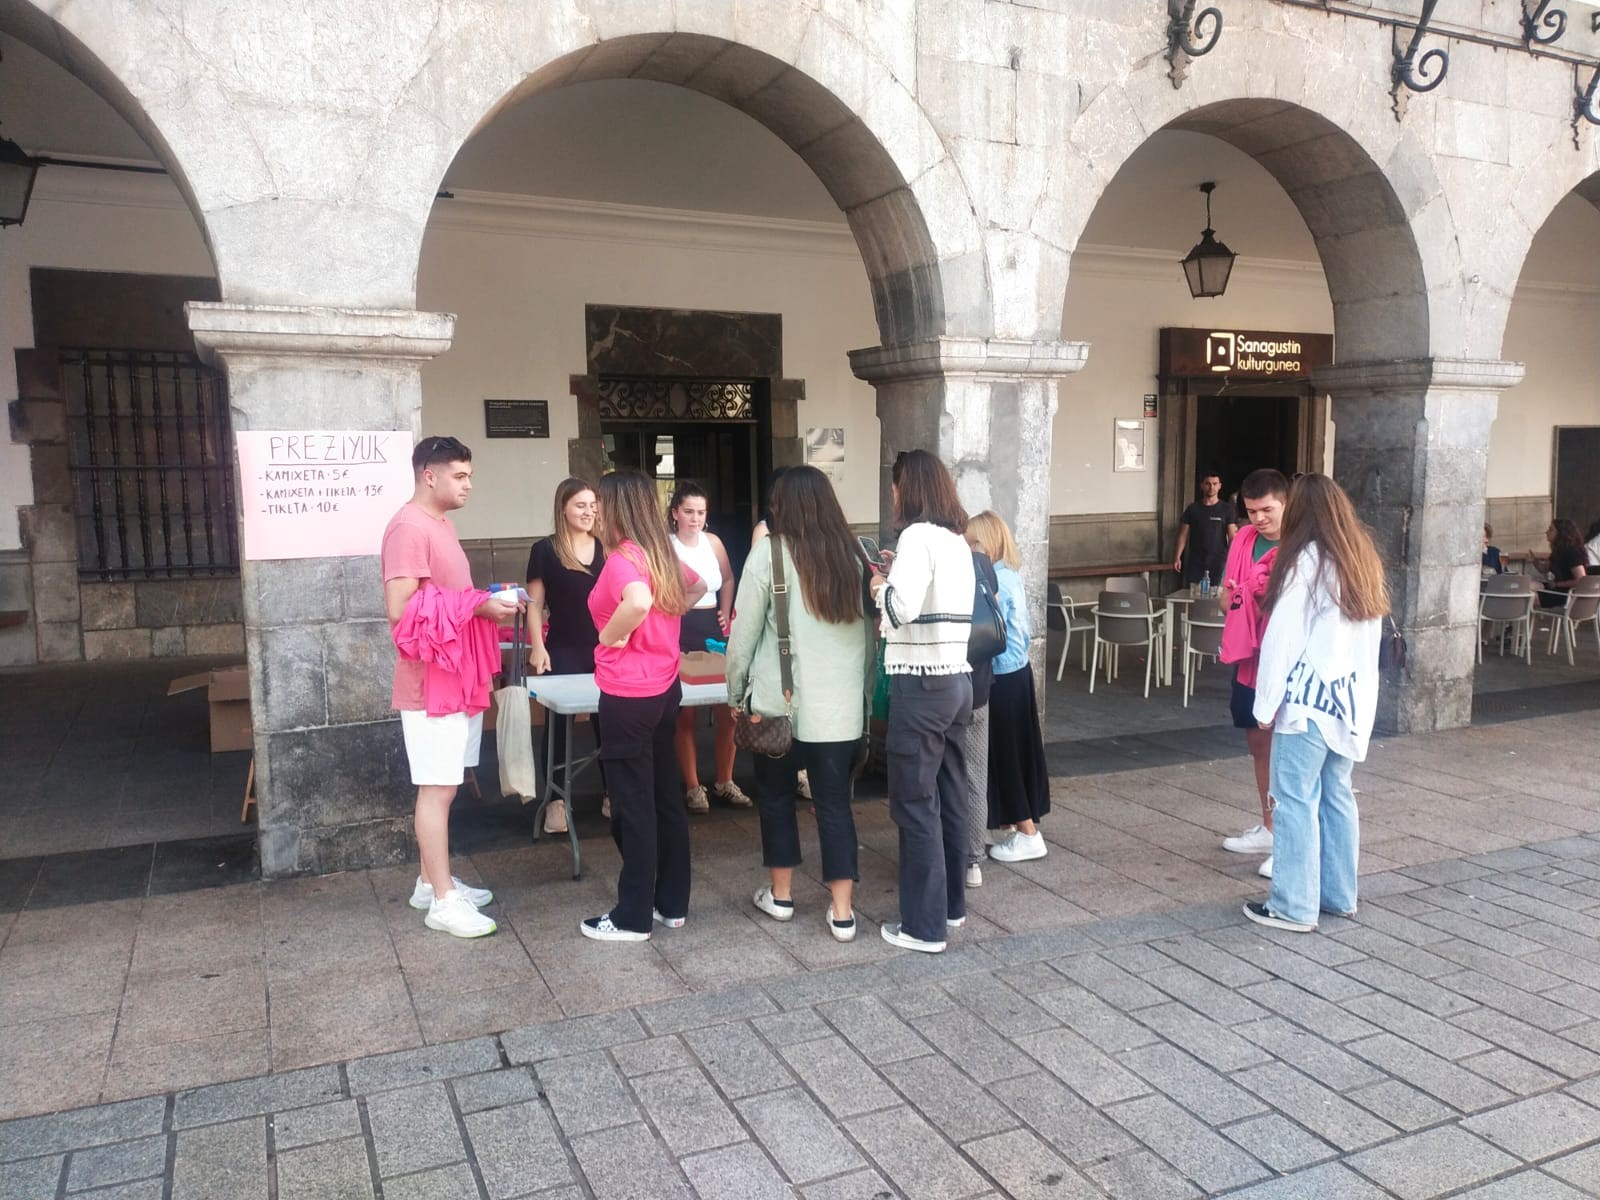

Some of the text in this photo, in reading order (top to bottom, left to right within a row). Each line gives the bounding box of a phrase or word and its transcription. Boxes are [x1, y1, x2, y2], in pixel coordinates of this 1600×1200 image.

[1237, 334, 1301, 357] Sanagustin
[1237, 352, 1300, 374] kulturgunea
[270, 434, 389, 463] PREZIYUK
